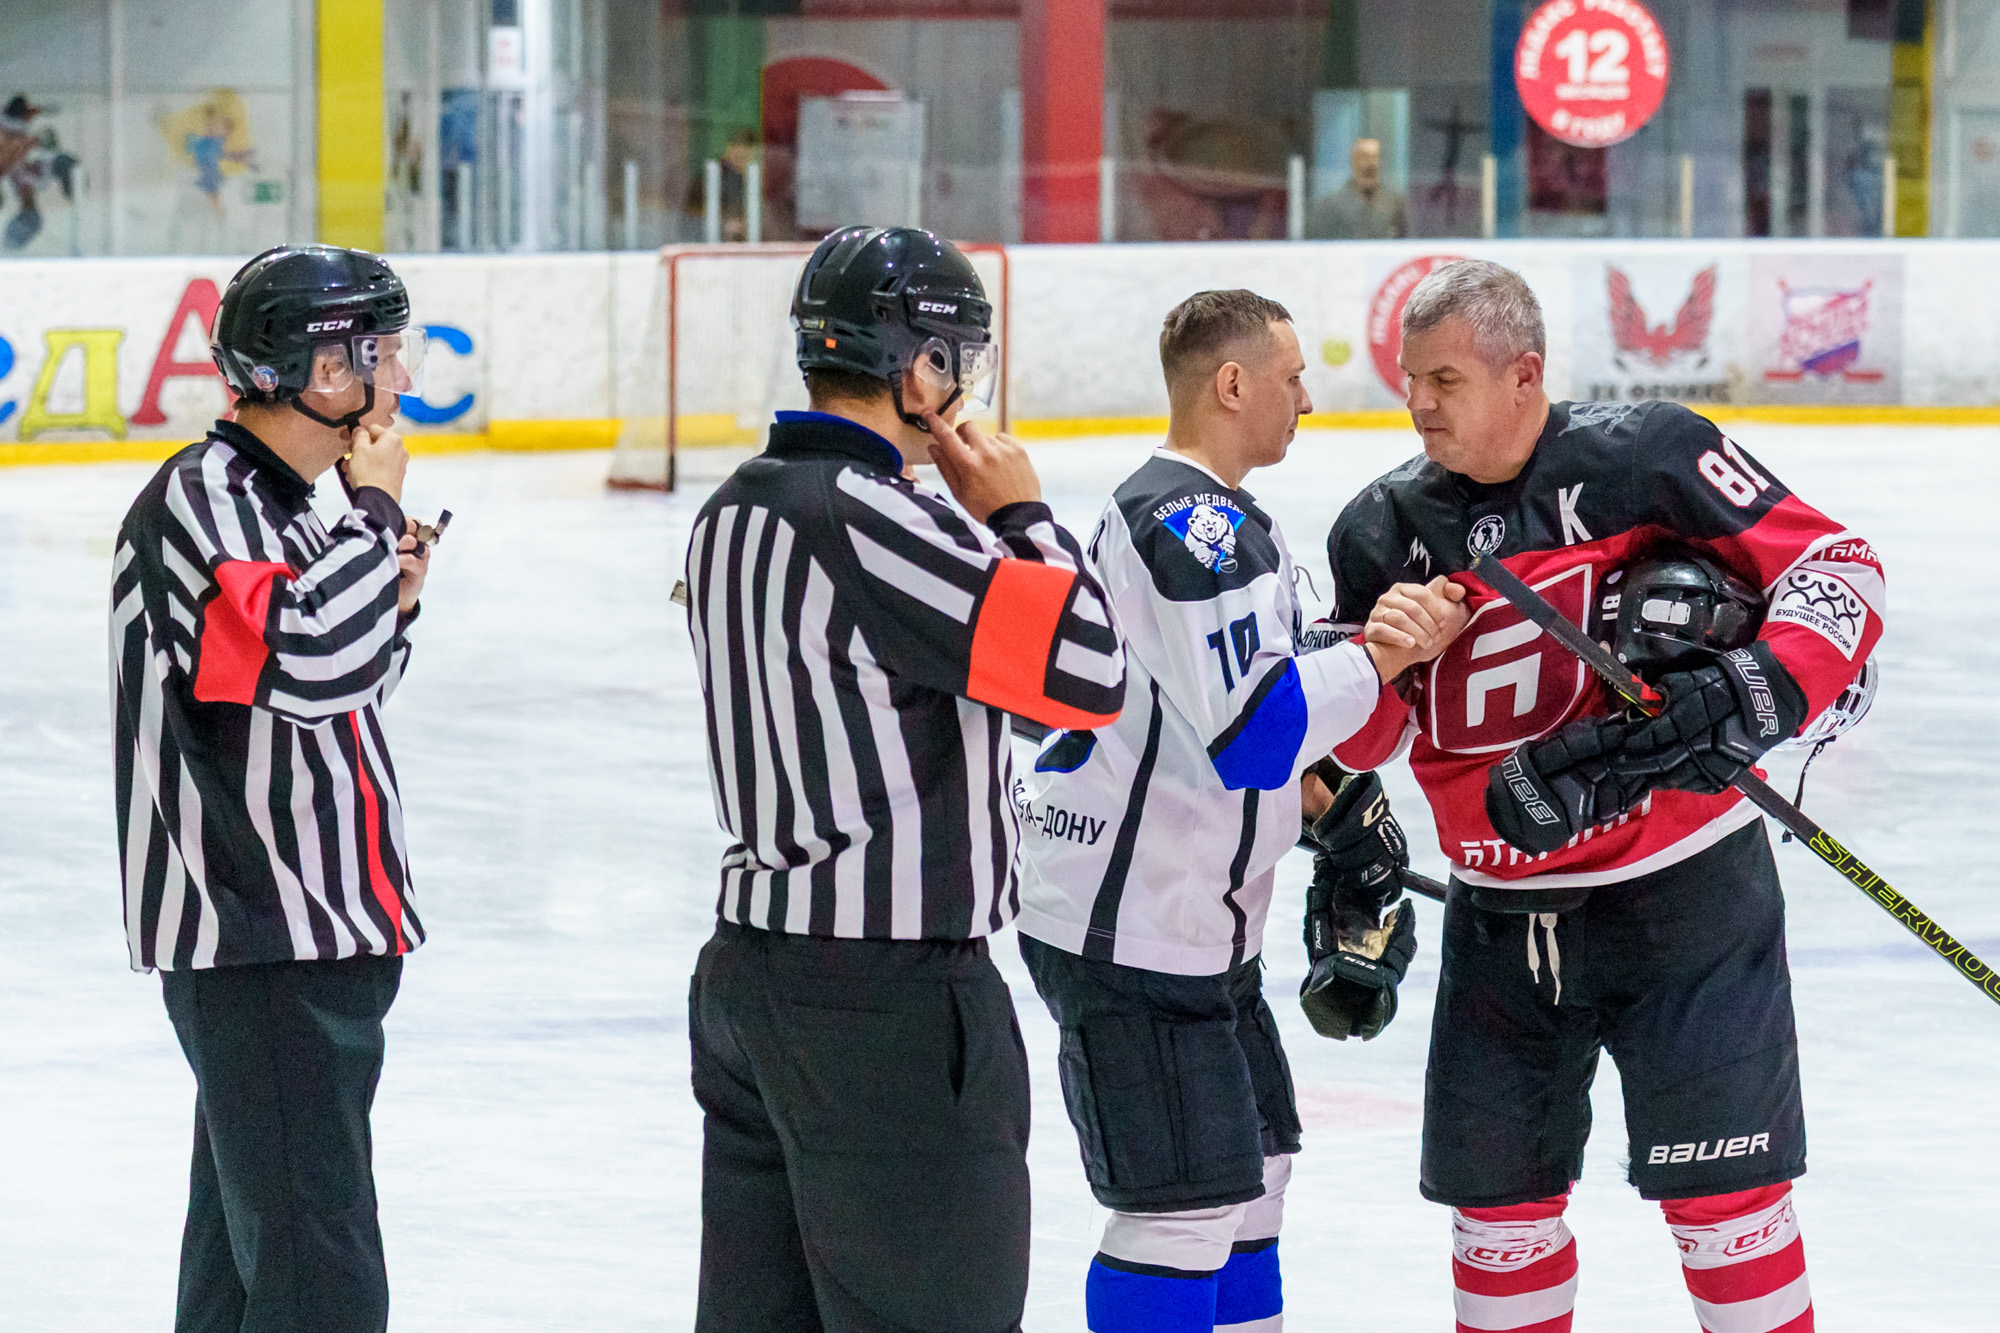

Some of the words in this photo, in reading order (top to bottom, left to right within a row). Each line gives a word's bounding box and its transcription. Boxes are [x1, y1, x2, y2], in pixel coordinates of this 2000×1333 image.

[1555, 28, 1630, 84] 12
[306, 318, 354, 333] CCM
[917, 301, 958, 315] CCM
[1697, 435, 1771, 508] 81
[1152, 496, 1194, 522] БЕЛЫЕ
[1775, 608, 1821, 628] БУДУЩЕЕ
[1821, 622, 1852, 651] РОССИИ
[1206, 611, 1260, 695] 10
[1723, 648, 1780, 738] AUER
[1647, 1132, 1770, 1165] BAUER
